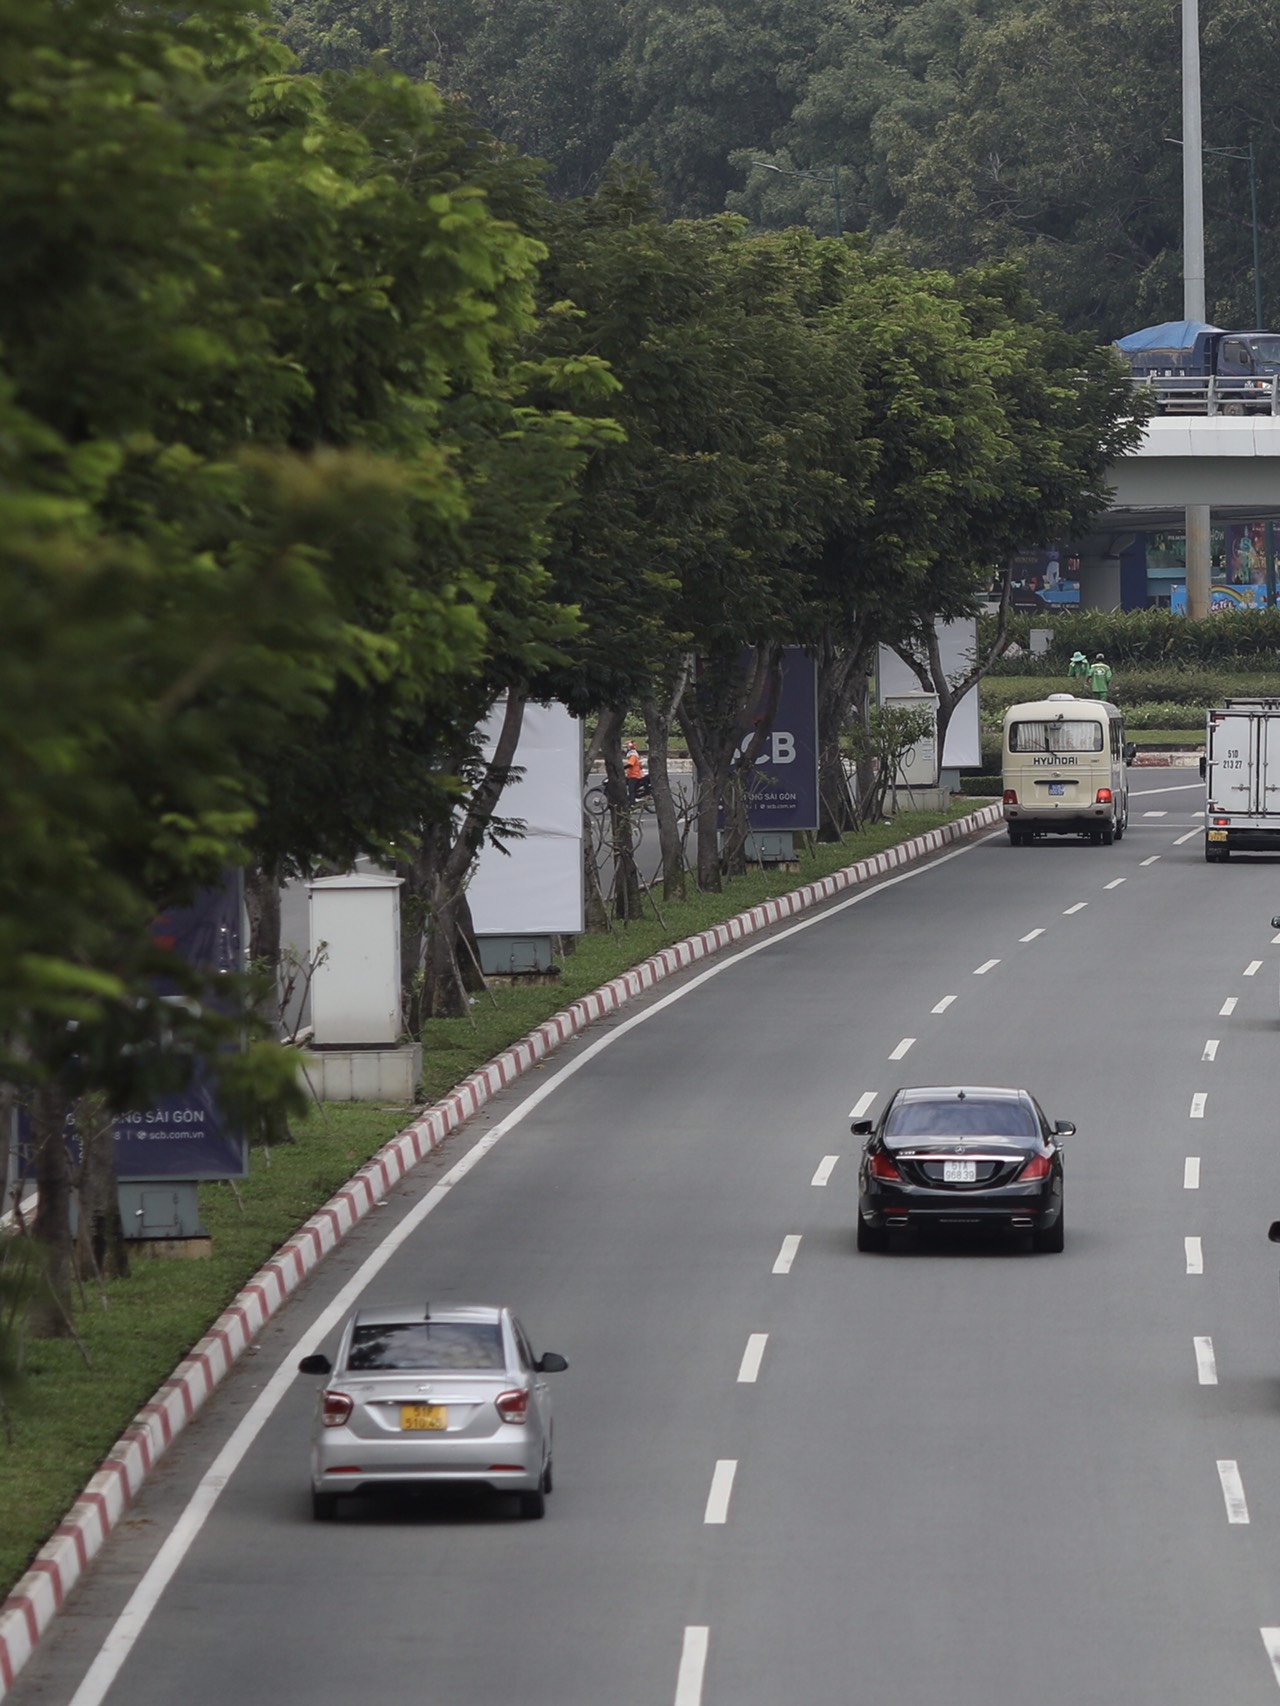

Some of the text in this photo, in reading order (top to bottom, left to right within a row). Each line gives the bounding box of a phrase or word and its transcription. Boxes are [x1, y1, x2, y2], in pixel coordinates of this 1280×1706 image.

[1228, 750, 1239, 758] 51D
[145, 1108, 169, 1123] SÀI
[173, 1107, 204, 1123] GÒN
[149, 1131, 204, 1140] scb.com.vn
